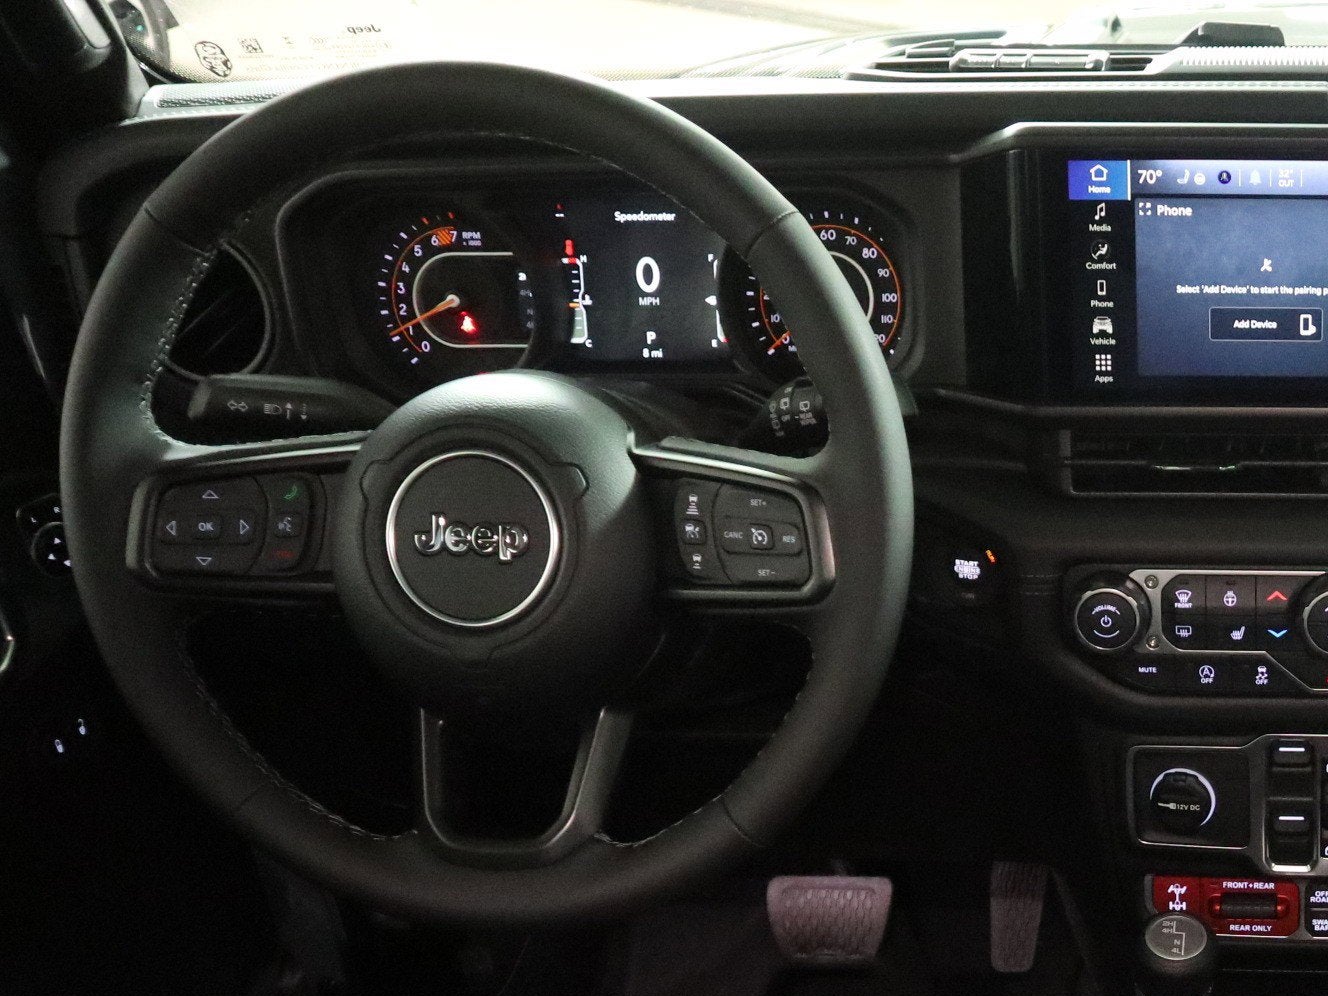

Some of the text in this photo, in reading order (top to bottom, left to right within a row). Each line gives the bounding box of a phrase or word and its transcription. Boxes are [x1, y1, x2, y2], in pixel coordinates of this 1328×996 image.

[1138, 170, 1162, 184] 70°
[1278, 180, 1294, 188] OUT
[1088, 185, 1111, 194] Home
[1156, 204, 1193, 216] Phone
[614, 211, 676, 223] Speedometer
[1088, 224, 1112, 232] Media
[450, 231, 457, 242] 7
[462, 232, 481, 240] RPM
[820, 230, 836, 240] 60
[431, 235, 439, 246] 6
[845, 236, 857, 245] 70
[414, 245, 423, 257] 5
[862, 248, 878, 258] 80
[402, 262, 410, 273] 4
[1085, 262, 1117, 270] Comfort
[635, 256, 660, 293] 0
[878, 268, 890, 278] 90
[397, 282, 405, 294] 3
[1176, 284, 1200, 294] Select
[1202, 284, 1220, 294] 'Add
[1220, 285, 1250, 294] Device'
[1250, 286, 1260, 294] to
[1260, 286, 1279, 294] start
[1280, 286, 1294, 294] the
[1294, 286, 1322, 297] pairing
[638, 297, 660, 306] MPH
[882, 292, 897, 302] 100
[1090, 300, 1114, 308] Phone
[399, 304, 407, 315] 2
[770, 313, 780, 322] 10
[881, 314, 893, 324] 110
[1233, 320, 1278, 329] Add Device
[409, 325, 414, 336] 1
[646, 331, 656, 344] P
[422, 341, 430, 352] 0
[651, 348, 663, 358] mi
[1094, 375, 1114, 383] Apps
[198, 521, 214, 532] OK
[414, 512, 529, 562] Jeep
[724, 531, 744, 539] CANC
[955, 559, 979, 567] START
[958, 572, 979, 580] STOP
[1094, 604, 1117, 612] VOLUME
[1138, 666, 1158, 674] MUTE
[1255, 678, 1268, 686] OFF
[1222, 881, 1275, 890] FRONT+REAR
[1230, 924, 1250, 932] REAR
